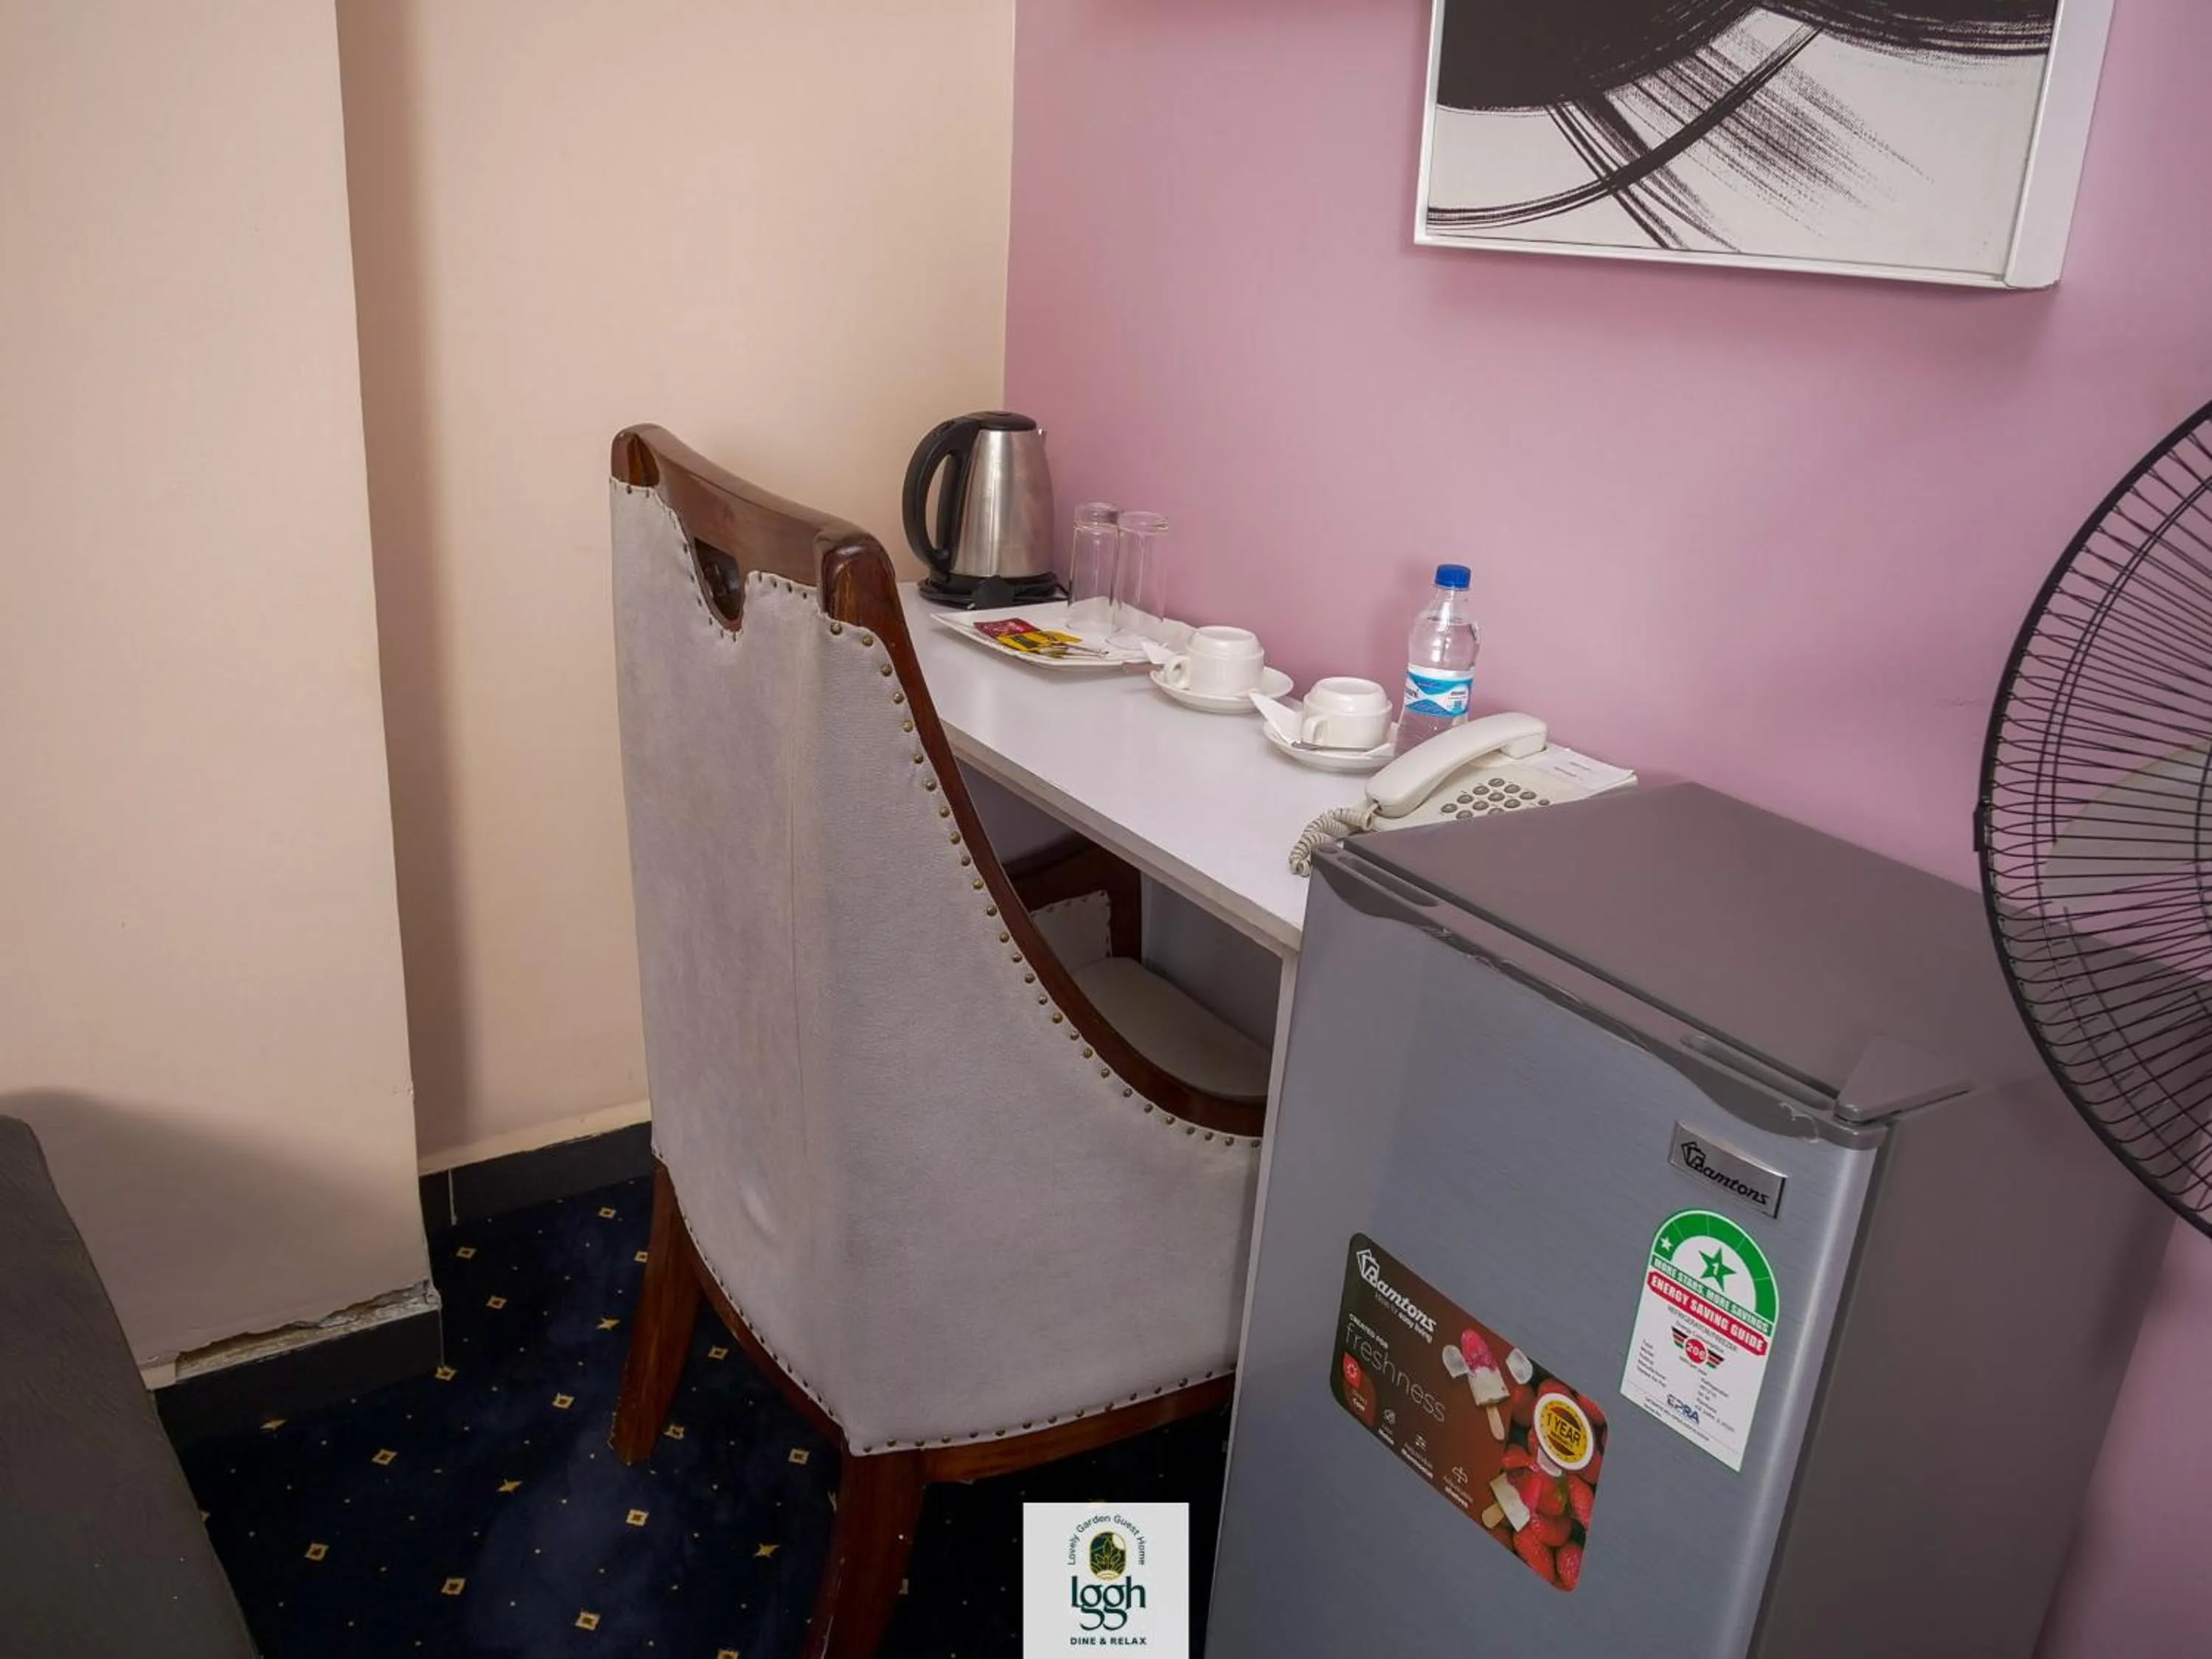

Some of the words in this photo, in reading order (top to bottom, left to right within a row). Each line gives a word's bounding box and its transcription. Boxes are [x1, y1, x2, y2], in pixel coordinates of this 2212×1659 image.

[1685, 1148, 1770, 1205] Ramtons
[1362, 1260, 1437, 1333] Ramtons
[1651, 1275, 1688, 1305] ENERGY
[1690, 1297, 1729, 1329] SAVING
[1731, 1321, 1764, 1350] GUIDE
[1654, 1259, 1678, 1280] MORE
[1706, 1289, 1731, 1310] MORE
[1346, 1323, 1446, 1422] freshness
[1546, 1413, 1551, 1426] 1
[1554, 1416, 1581, 1446] YEAR
